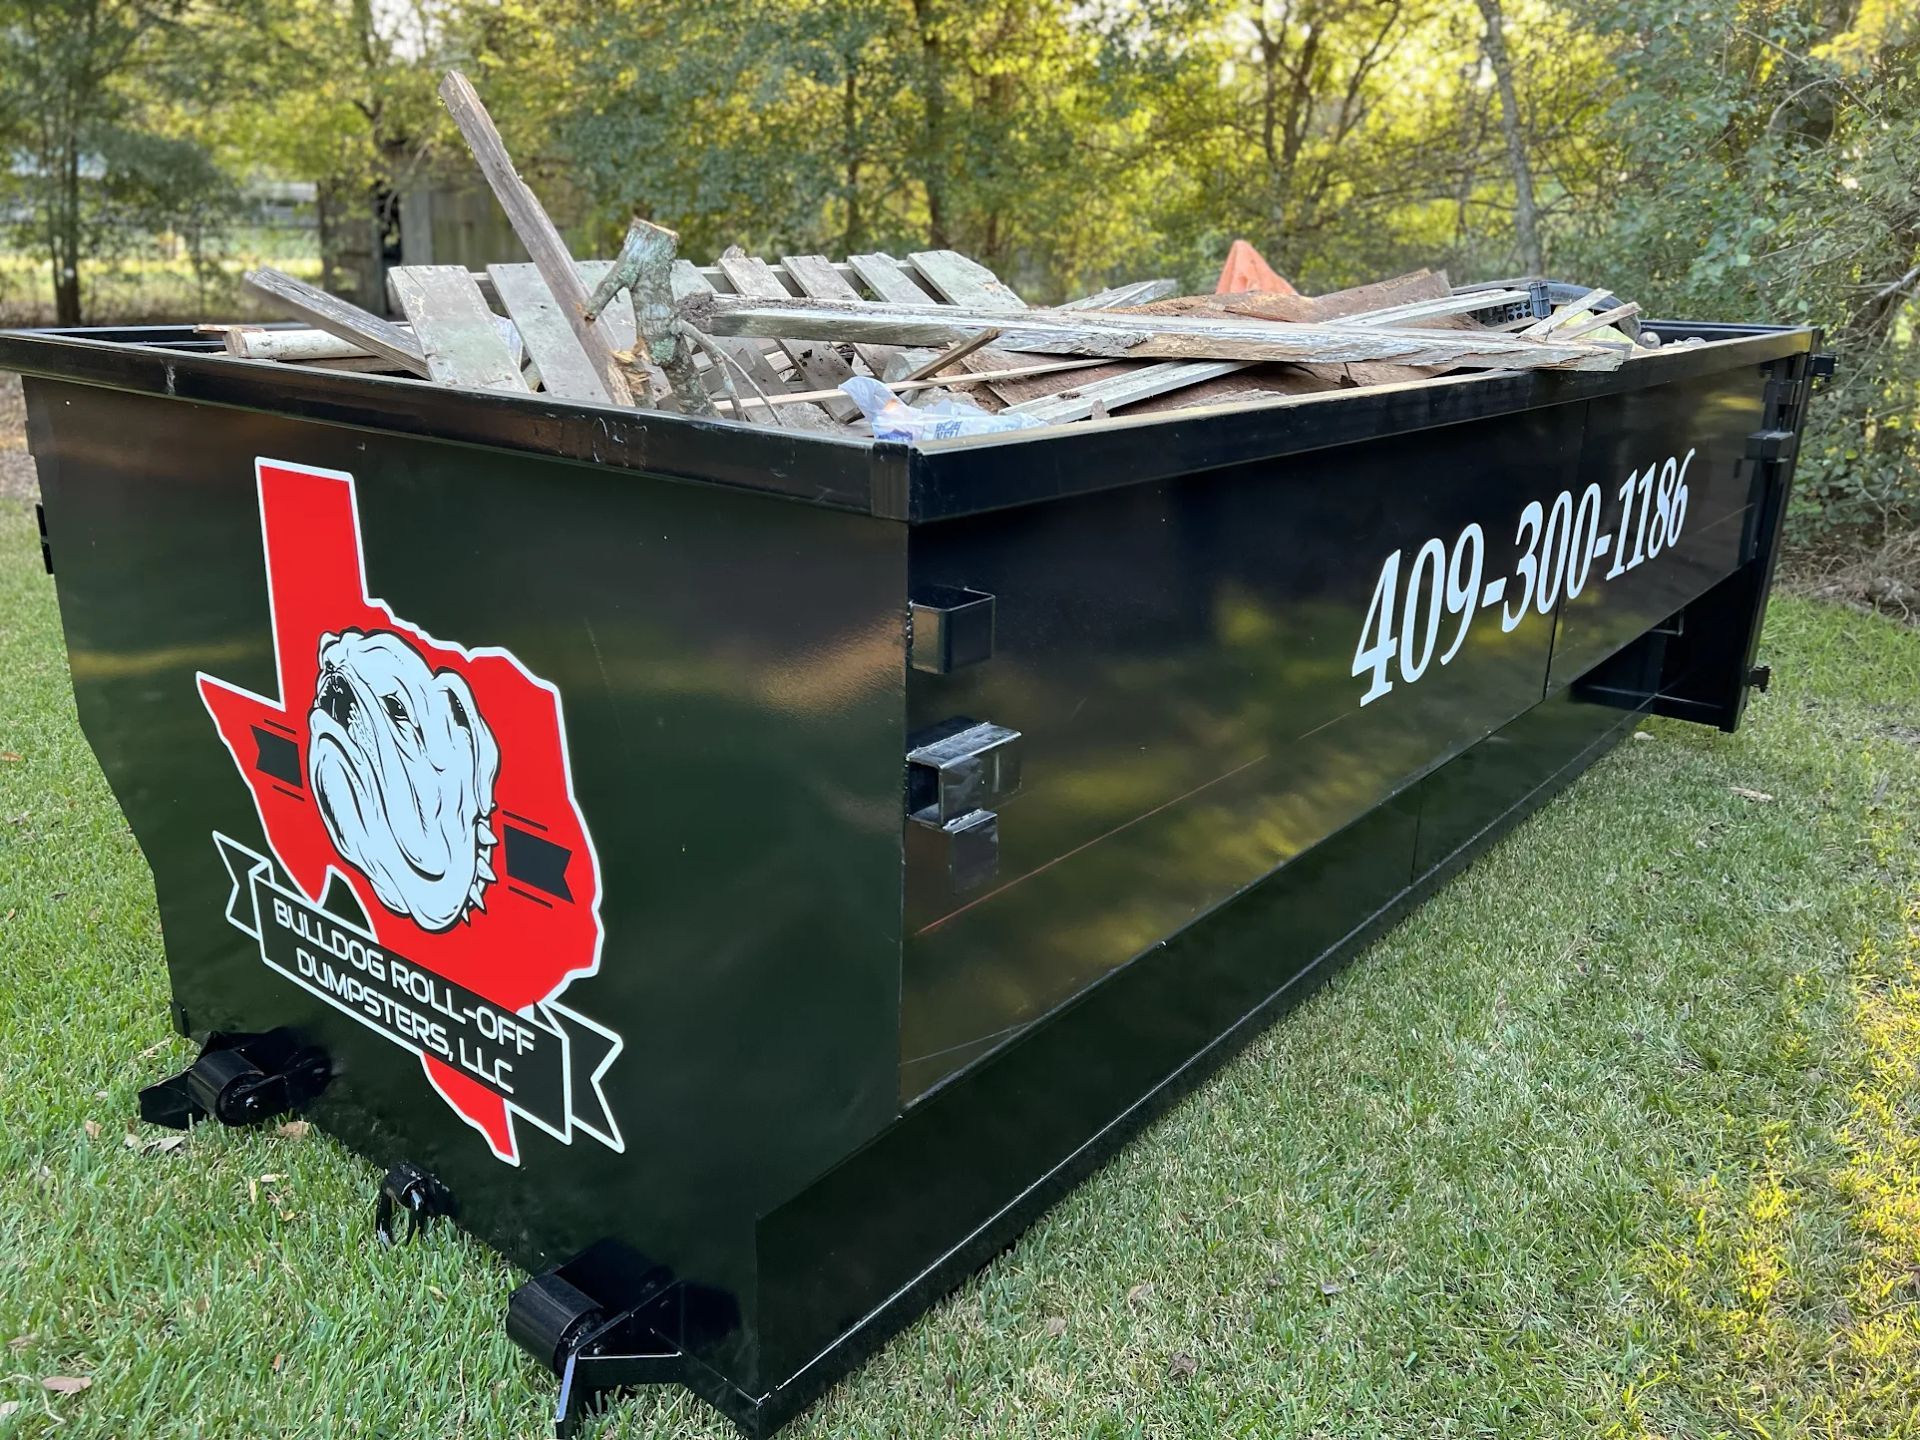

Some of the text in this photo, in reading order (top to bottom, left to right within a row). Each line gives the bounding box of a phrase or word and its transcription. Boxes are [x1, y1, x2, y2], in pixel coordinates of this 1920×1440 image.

[1352, 448, 1695, 707] 409-300-1186
[274, 899, 536, 1055] BULLDOG ROLL-OFF
[297, 948, 515, 1095] DUMPSTERS, LLC
